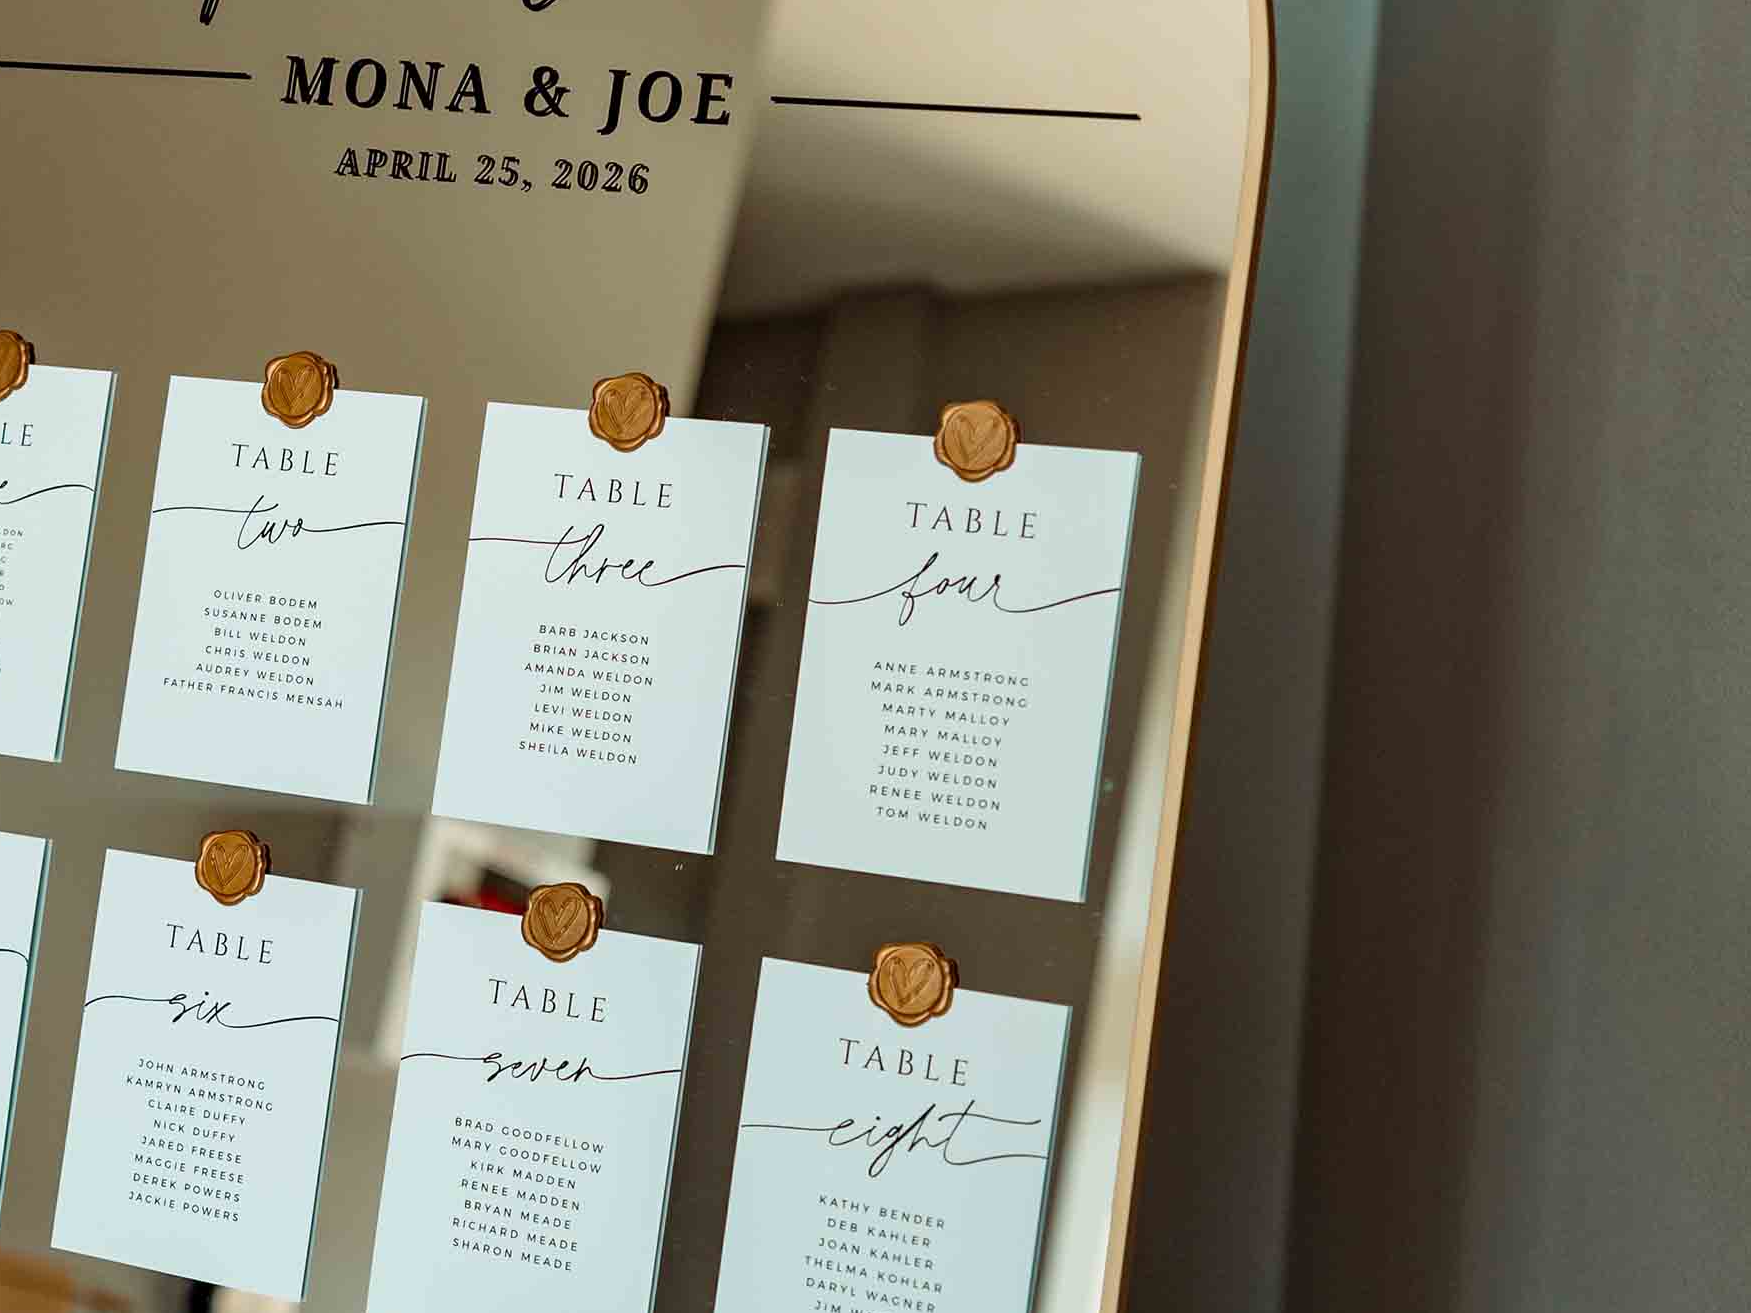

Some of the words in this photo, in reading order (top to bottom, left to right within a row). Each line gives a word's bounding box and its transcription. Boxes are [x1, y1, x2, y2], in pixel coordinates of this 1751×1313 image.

[279, 53, 494, 115] MONA
[524, 69, 572, 121] &
[602, 67, 734, 136] JOE
[335, 147, 457, 185] APRIL
[475, 155, 534, 191] 25,
[553, 159, 652, 197] 2026
[231, 443, 339, 476] TABLE
[554, 474, 672, 509] TABLE
[905, 501, 1036, 539] TABLE
[212, 588, 263, 604] OLIVER
[268, 594, 318, 611] BODEM
[203, 606, 267, 624] SUSANNE
[272, 614, 323, 630] BODEM
[213, 626, 242, 640] BILL
[248, 630, 307, 648] WELDON
[538, 623, 577, 639] BARB
[582, 628, 650, 647] JACKSON
[204, 644, 246, 660] CHRIS
[251, 650, 311, 668] WELDON
[532, 642, 578, 658] BRIAN
[583, 648, 651, 667] JACKSON
[162, 676, 214, 693] FATHER
[219, 683, 279, 702] FRANCIS
[284, 692, 344, 710] MENSAH
[538, 682, 565, 696] JIM
[570, 686, 632, 704] WELDON
[881, 702, 937, 718] MARTY
[943, 709, 1011, 728] MALLOY
[528, 721, 565, 736] MIKE
[570, 726, 633, 744] WELDON
[517, 739, 570, 757] SHEILA
[575, 746, 638, 766] WELDON
[881, 743, 921, 759] JEFF
[927, 749, 998, 768] WELDON
[868, 783, 923, 802] RENEE
[930, 791, 1001, 812] WELDON
[876, 805, 910, 820] TOM
[917, 811, 988, 832] WELDON
[167, 924, 274, 964] TABLE
[489, 979, 607, 1022] TABLE
[839, 1038, 969, 1086] TABLE
[147, 1097, 197, 1118] CLAIRE
[202, 1108, 247, 1126] DUFFY
[152, 1118, 186, 1135] NICK
[191, 1125, 236, 1144] DUFFY
[140, 1134, 185, 1153] JARED
[190, 1144, 243, 1166] FREESE
[469, 1159, 505, 1176] KIRK
[511, 1167, 577, 1191] MADDEN
[127, 1189, 177, 1210] JACKIE
[181, 1200, 240, 1223] POWERS
[460, 1177, 509, 1198] RENEE
[515, 1188, 581, 1212] MADDEN
[463, 1198, 513, 1219] BRYAN
[519, 1209, 572, 1231] MEADE
[451, 1236, 514, 1260] SHARON
[519, 1250, 573, 1272] MEADE
